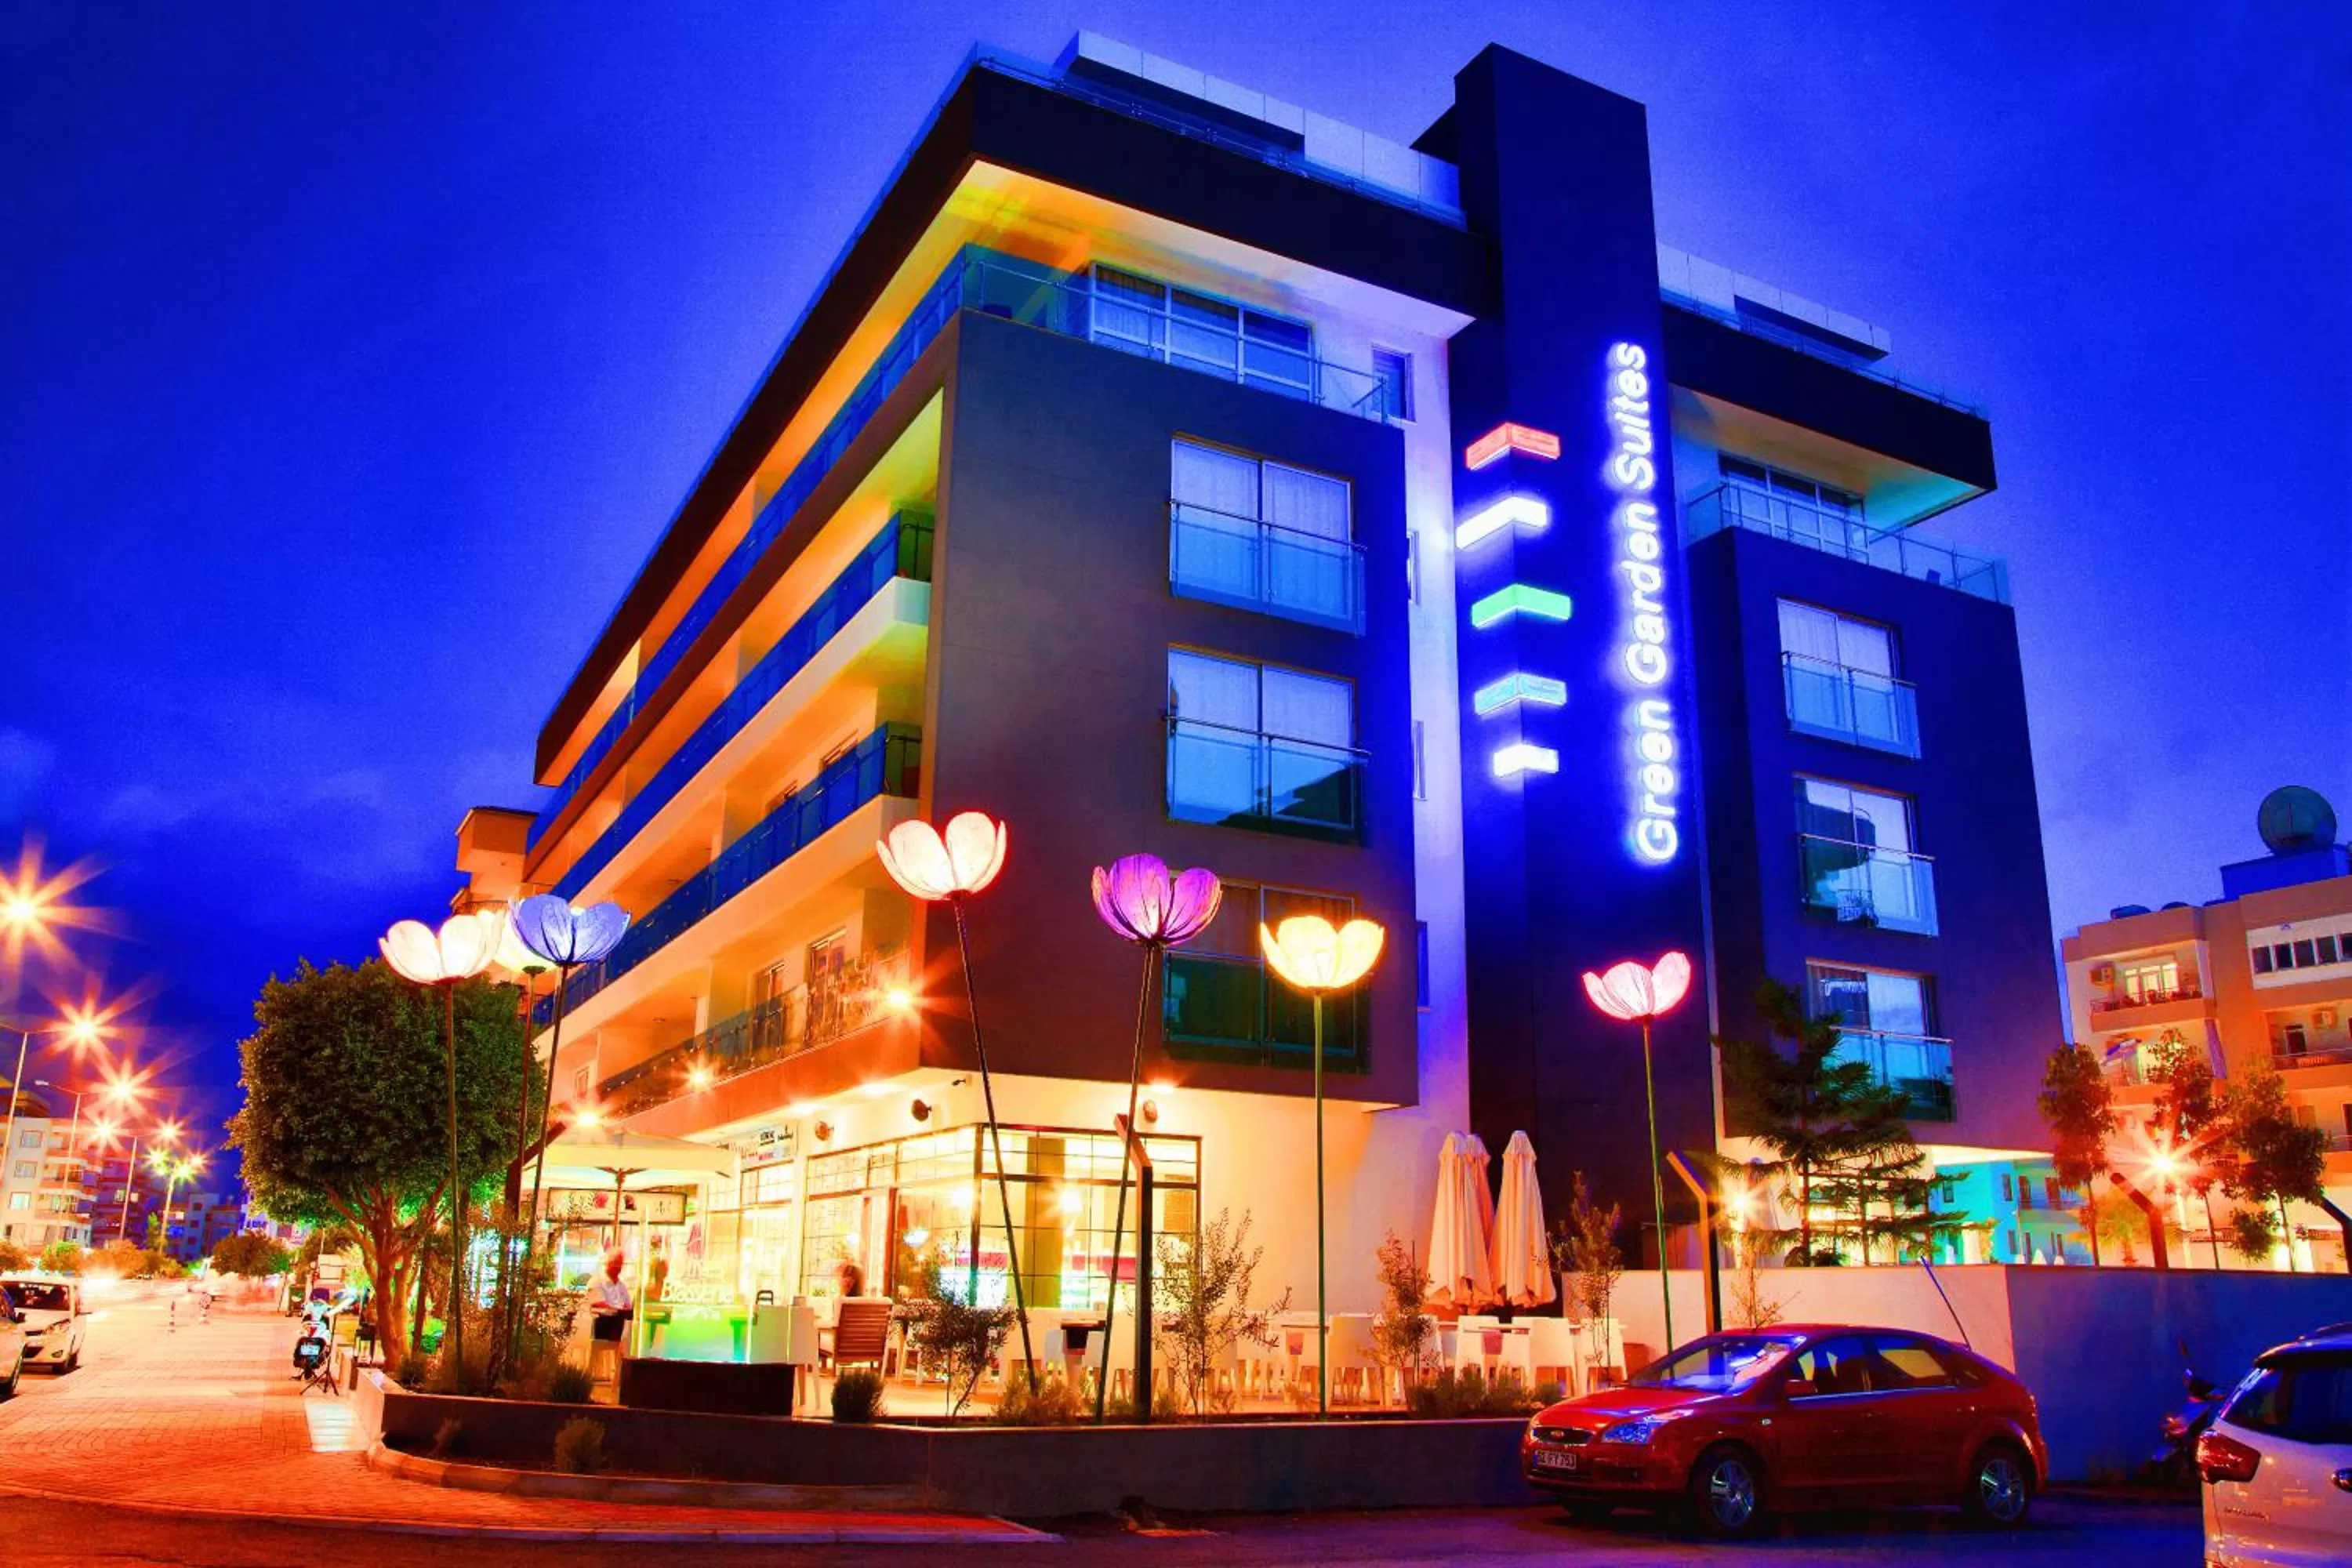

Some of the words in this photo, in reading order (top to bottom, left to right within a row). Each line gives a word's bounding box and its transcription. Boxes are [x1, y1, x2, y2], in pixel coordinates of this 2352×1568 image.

[1612, 342, 1655, 491] Suites
[1620, 503, 1668, 684] Garden
[1637, 699, 1679, 860] Green
